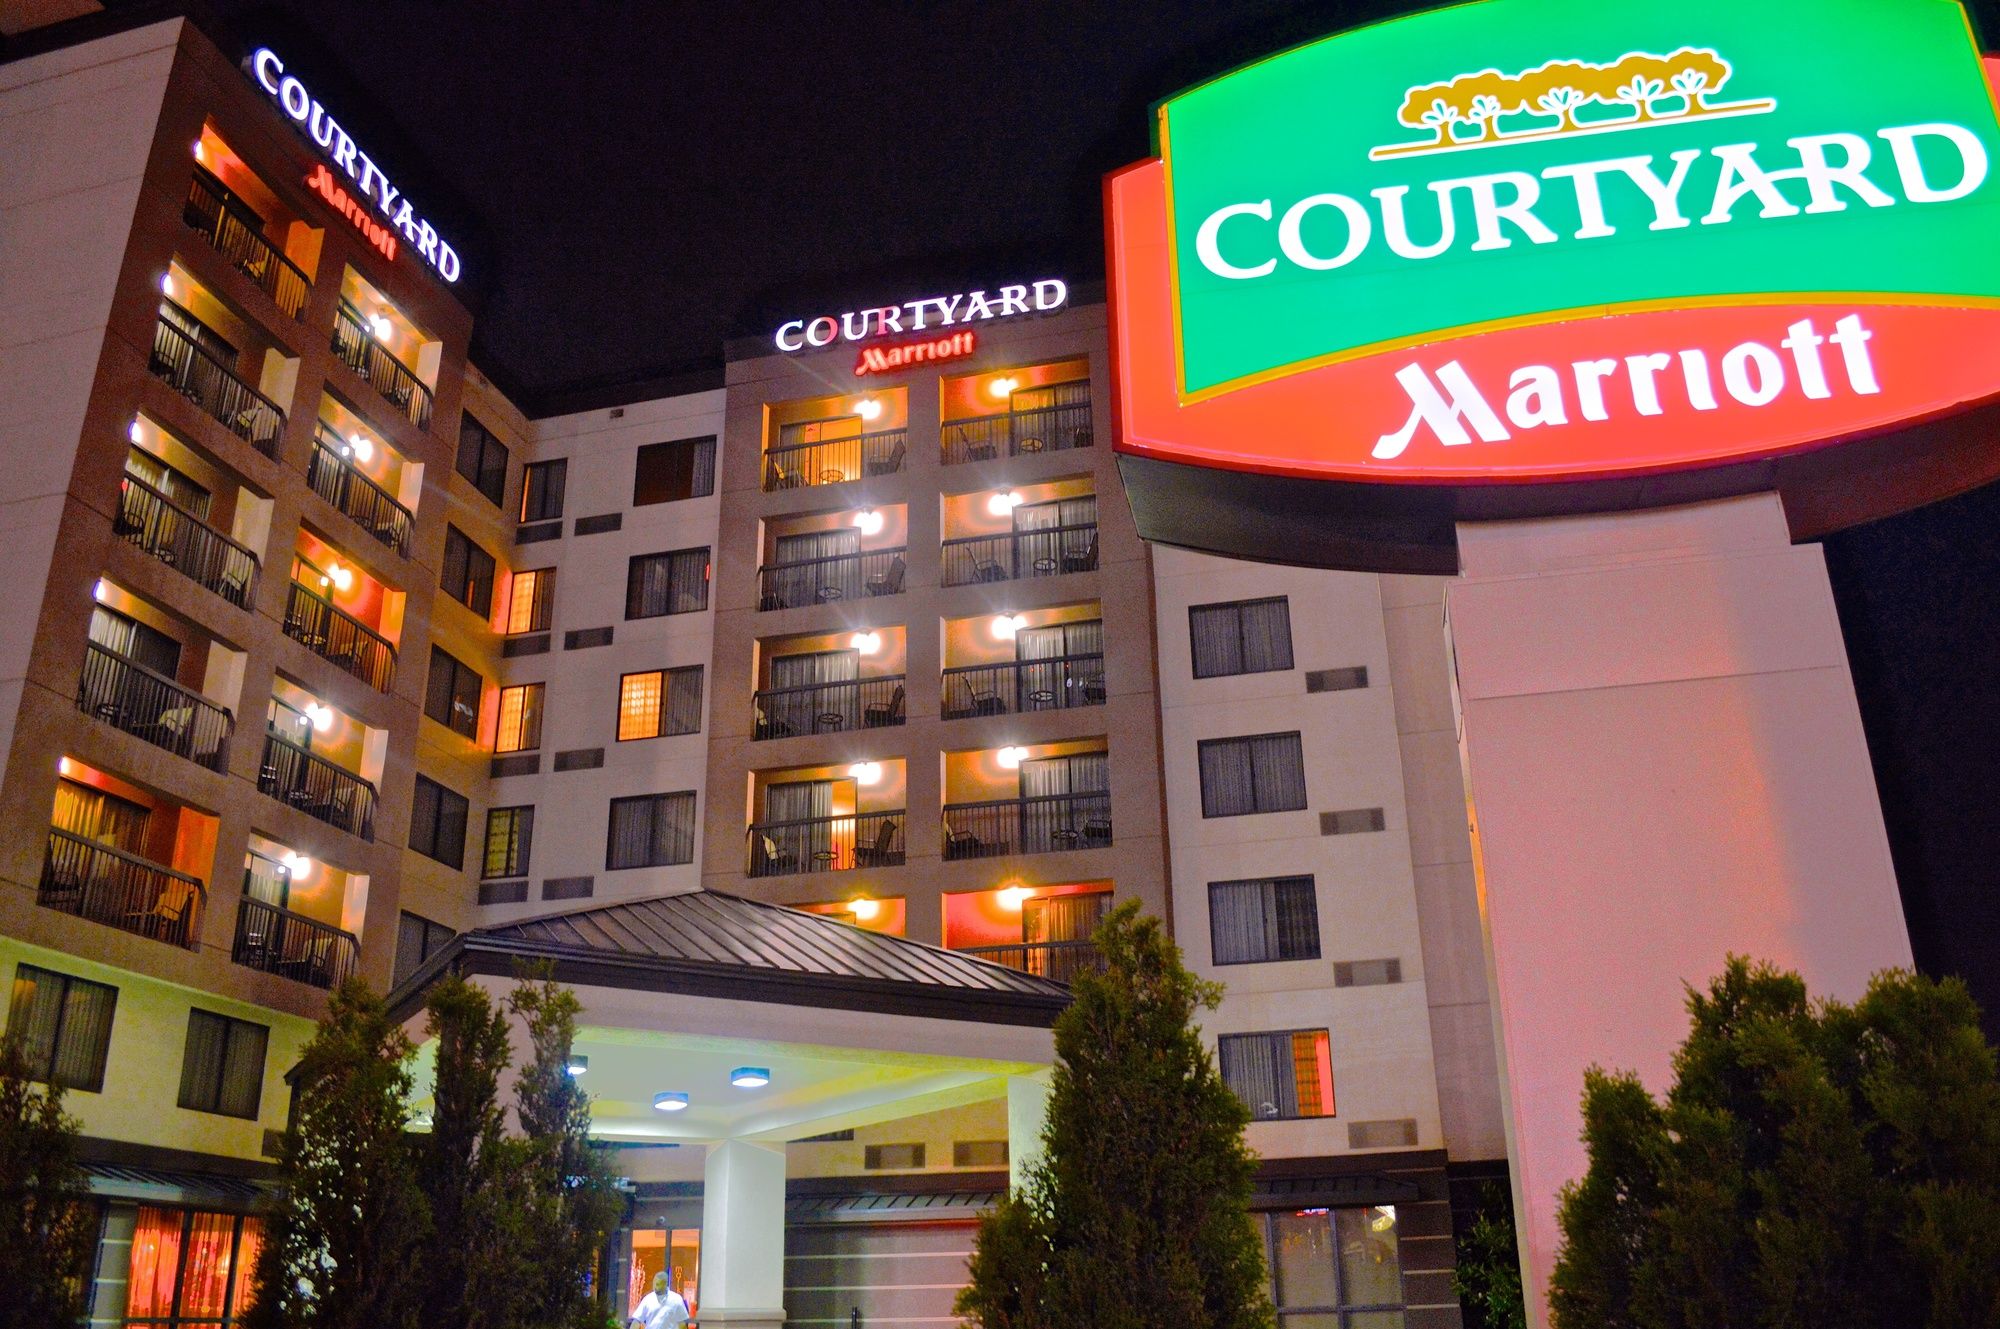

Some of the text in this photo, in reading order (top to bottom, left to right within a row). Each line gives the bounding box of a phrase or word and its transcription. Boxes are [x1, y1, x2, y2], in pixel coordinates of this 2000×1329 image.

[253, 48, 461, 282] COURTYARD
[308, 164, 396, 261] Marriott
[1195, 122, 1989, 279] COURTYARD
[774, 279, 1067, 352] COURTYARD
[855, 331, 974, 376] Marriott
[1371, 313, 1881, 460] Marriott
